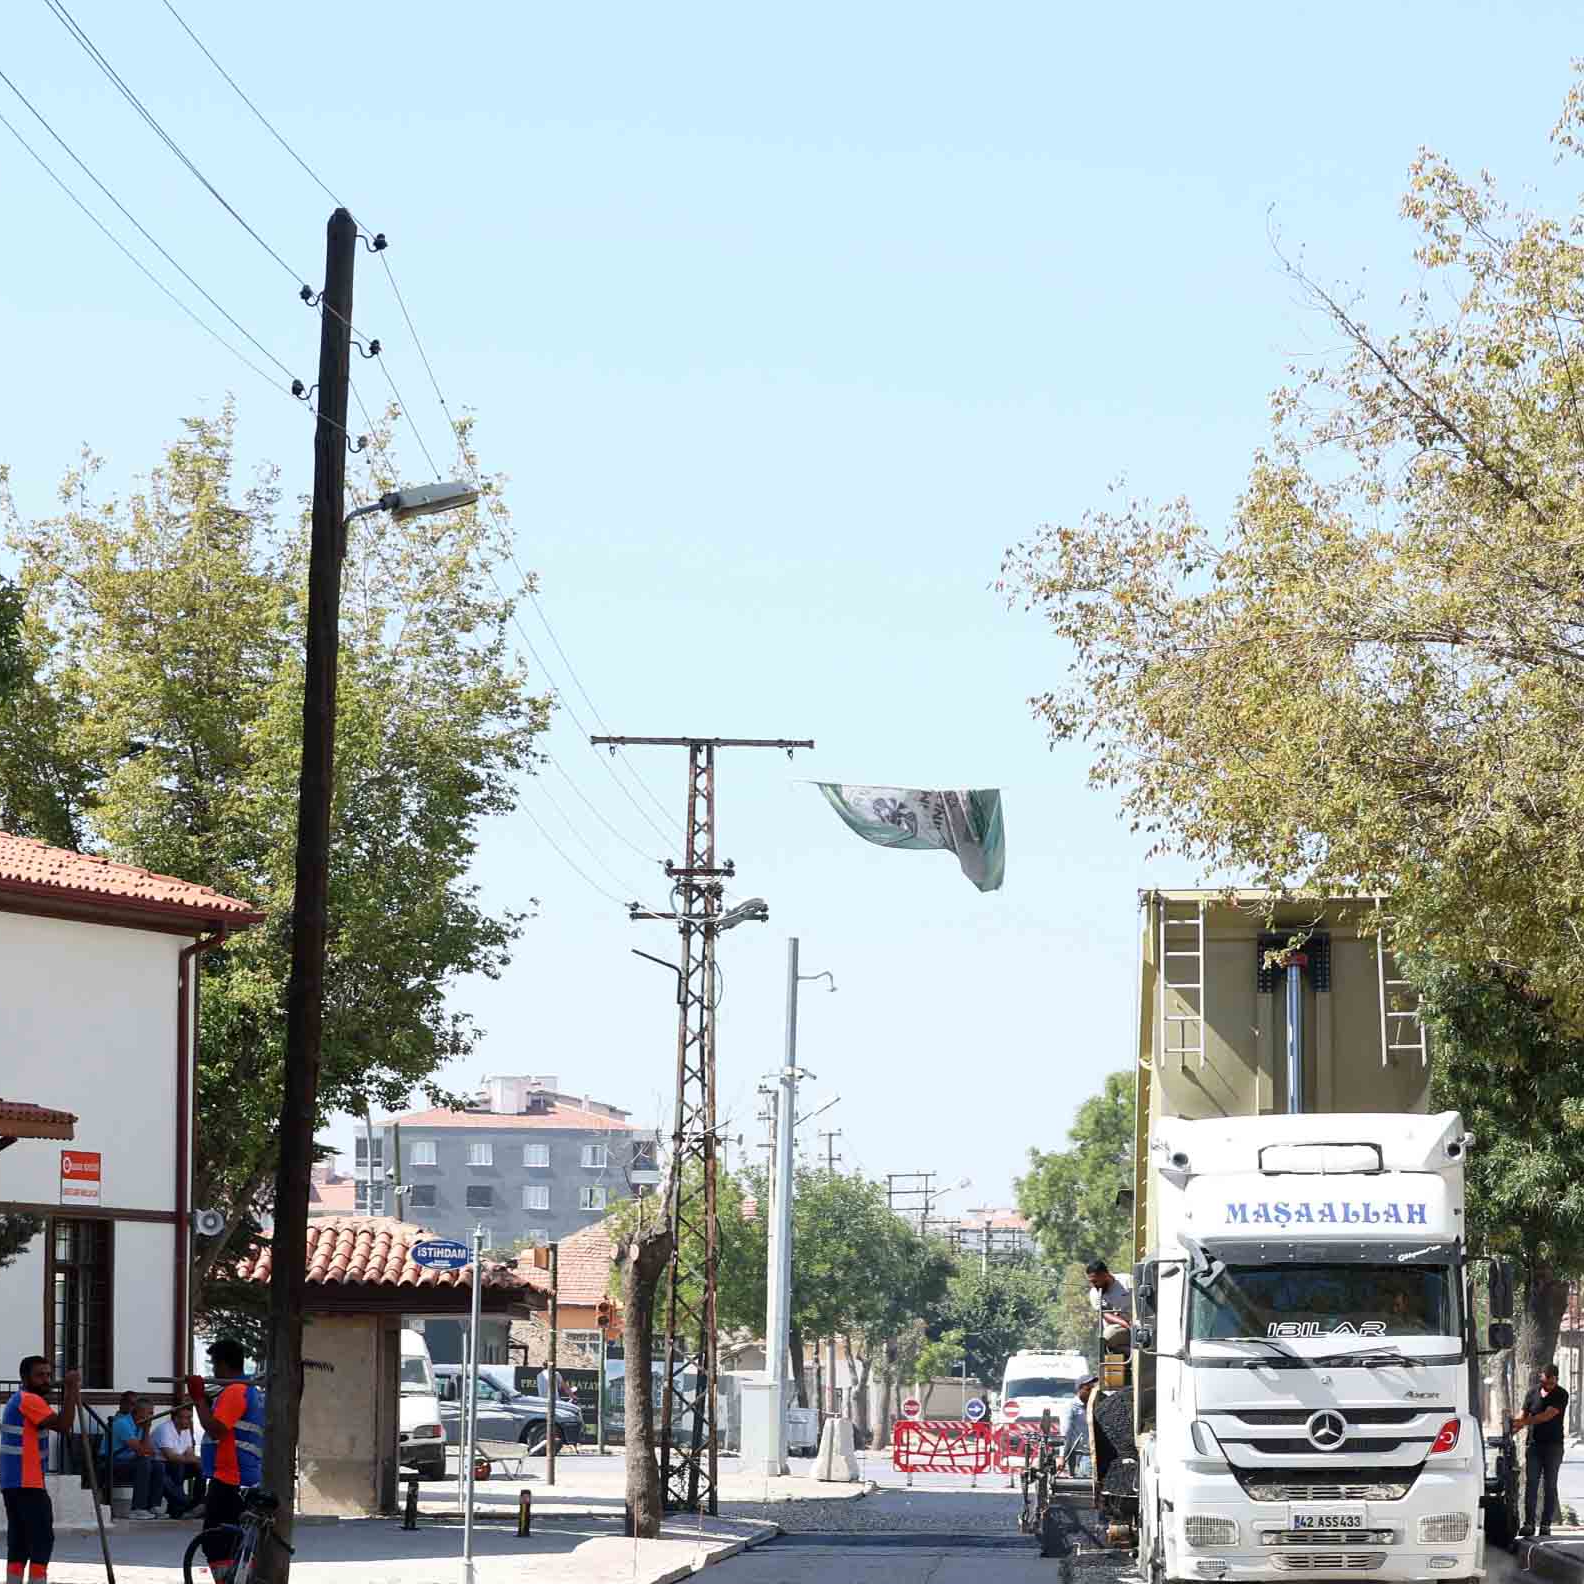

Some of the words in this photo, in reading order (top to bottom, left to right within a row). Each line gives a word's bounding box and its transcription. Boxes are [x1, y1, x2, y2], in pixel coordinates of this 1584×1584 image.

[1224, 1201, 1428, 1228] MAŞAALLAH
[417, 1246, 466, 1259] İSTİHDAM
[1300, 1516, 1314, 1528] 42
